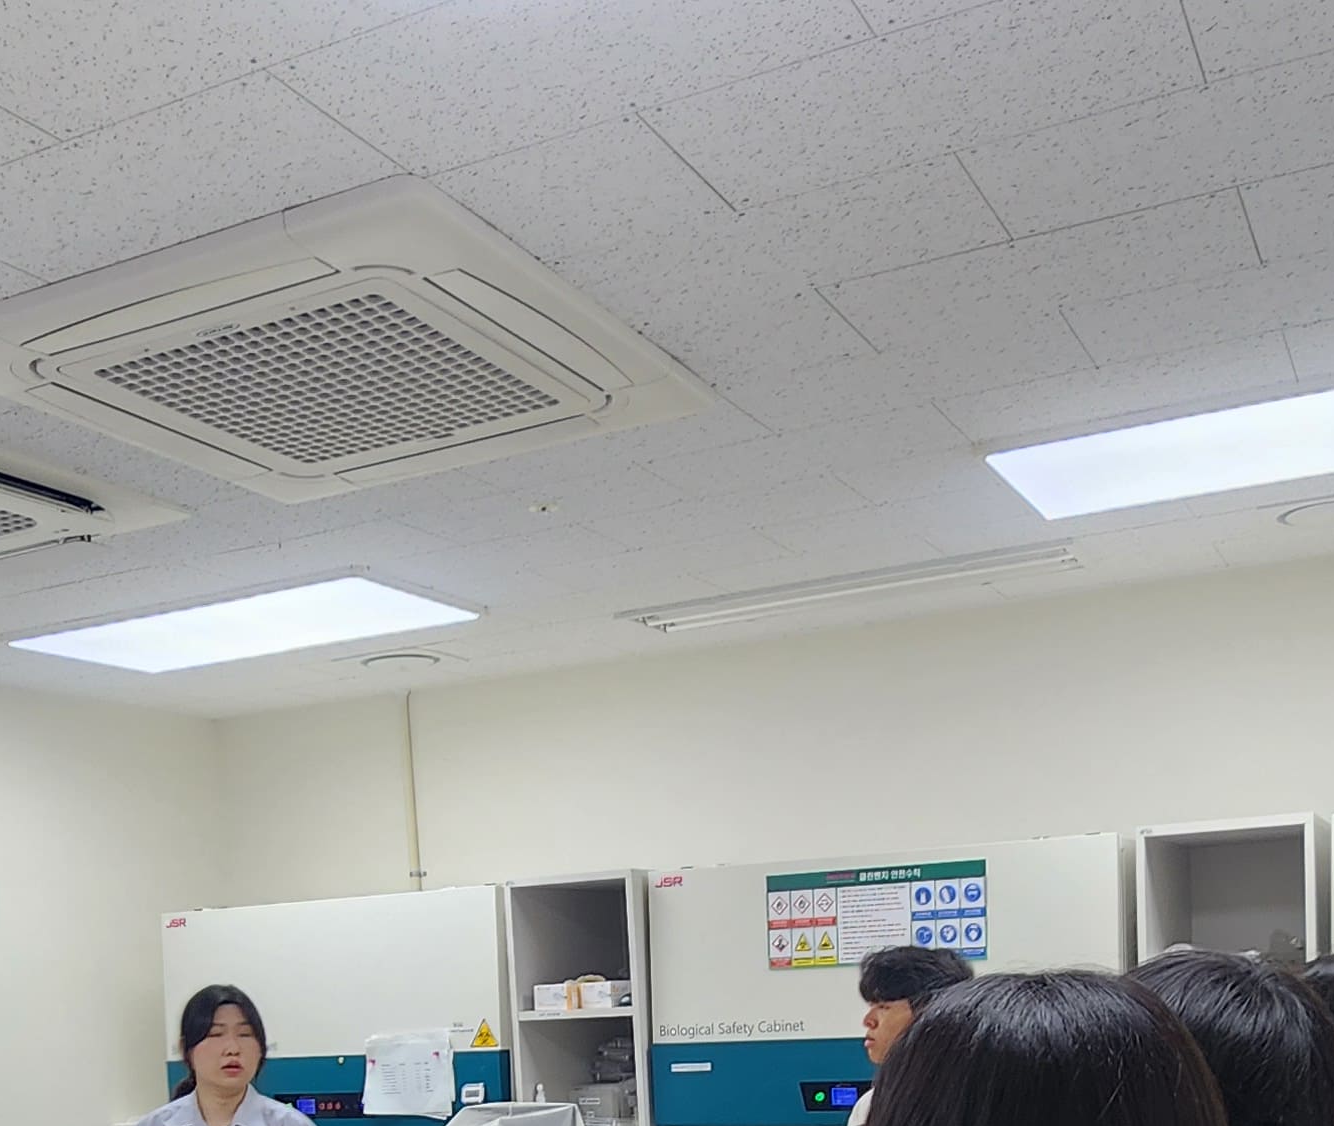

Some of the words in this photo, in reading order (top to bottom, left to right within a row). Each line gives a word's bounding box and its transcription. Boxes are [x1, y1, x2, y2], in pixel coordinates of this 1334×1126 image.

[654, 876, 683, 888] JSR
[166, 917, 187, 929] JSR
[659, 1023, 715, 1039] Biological
[718, 1021, 755, 1036] Safety
[757, 1020, 805, 1034] Cabinet
